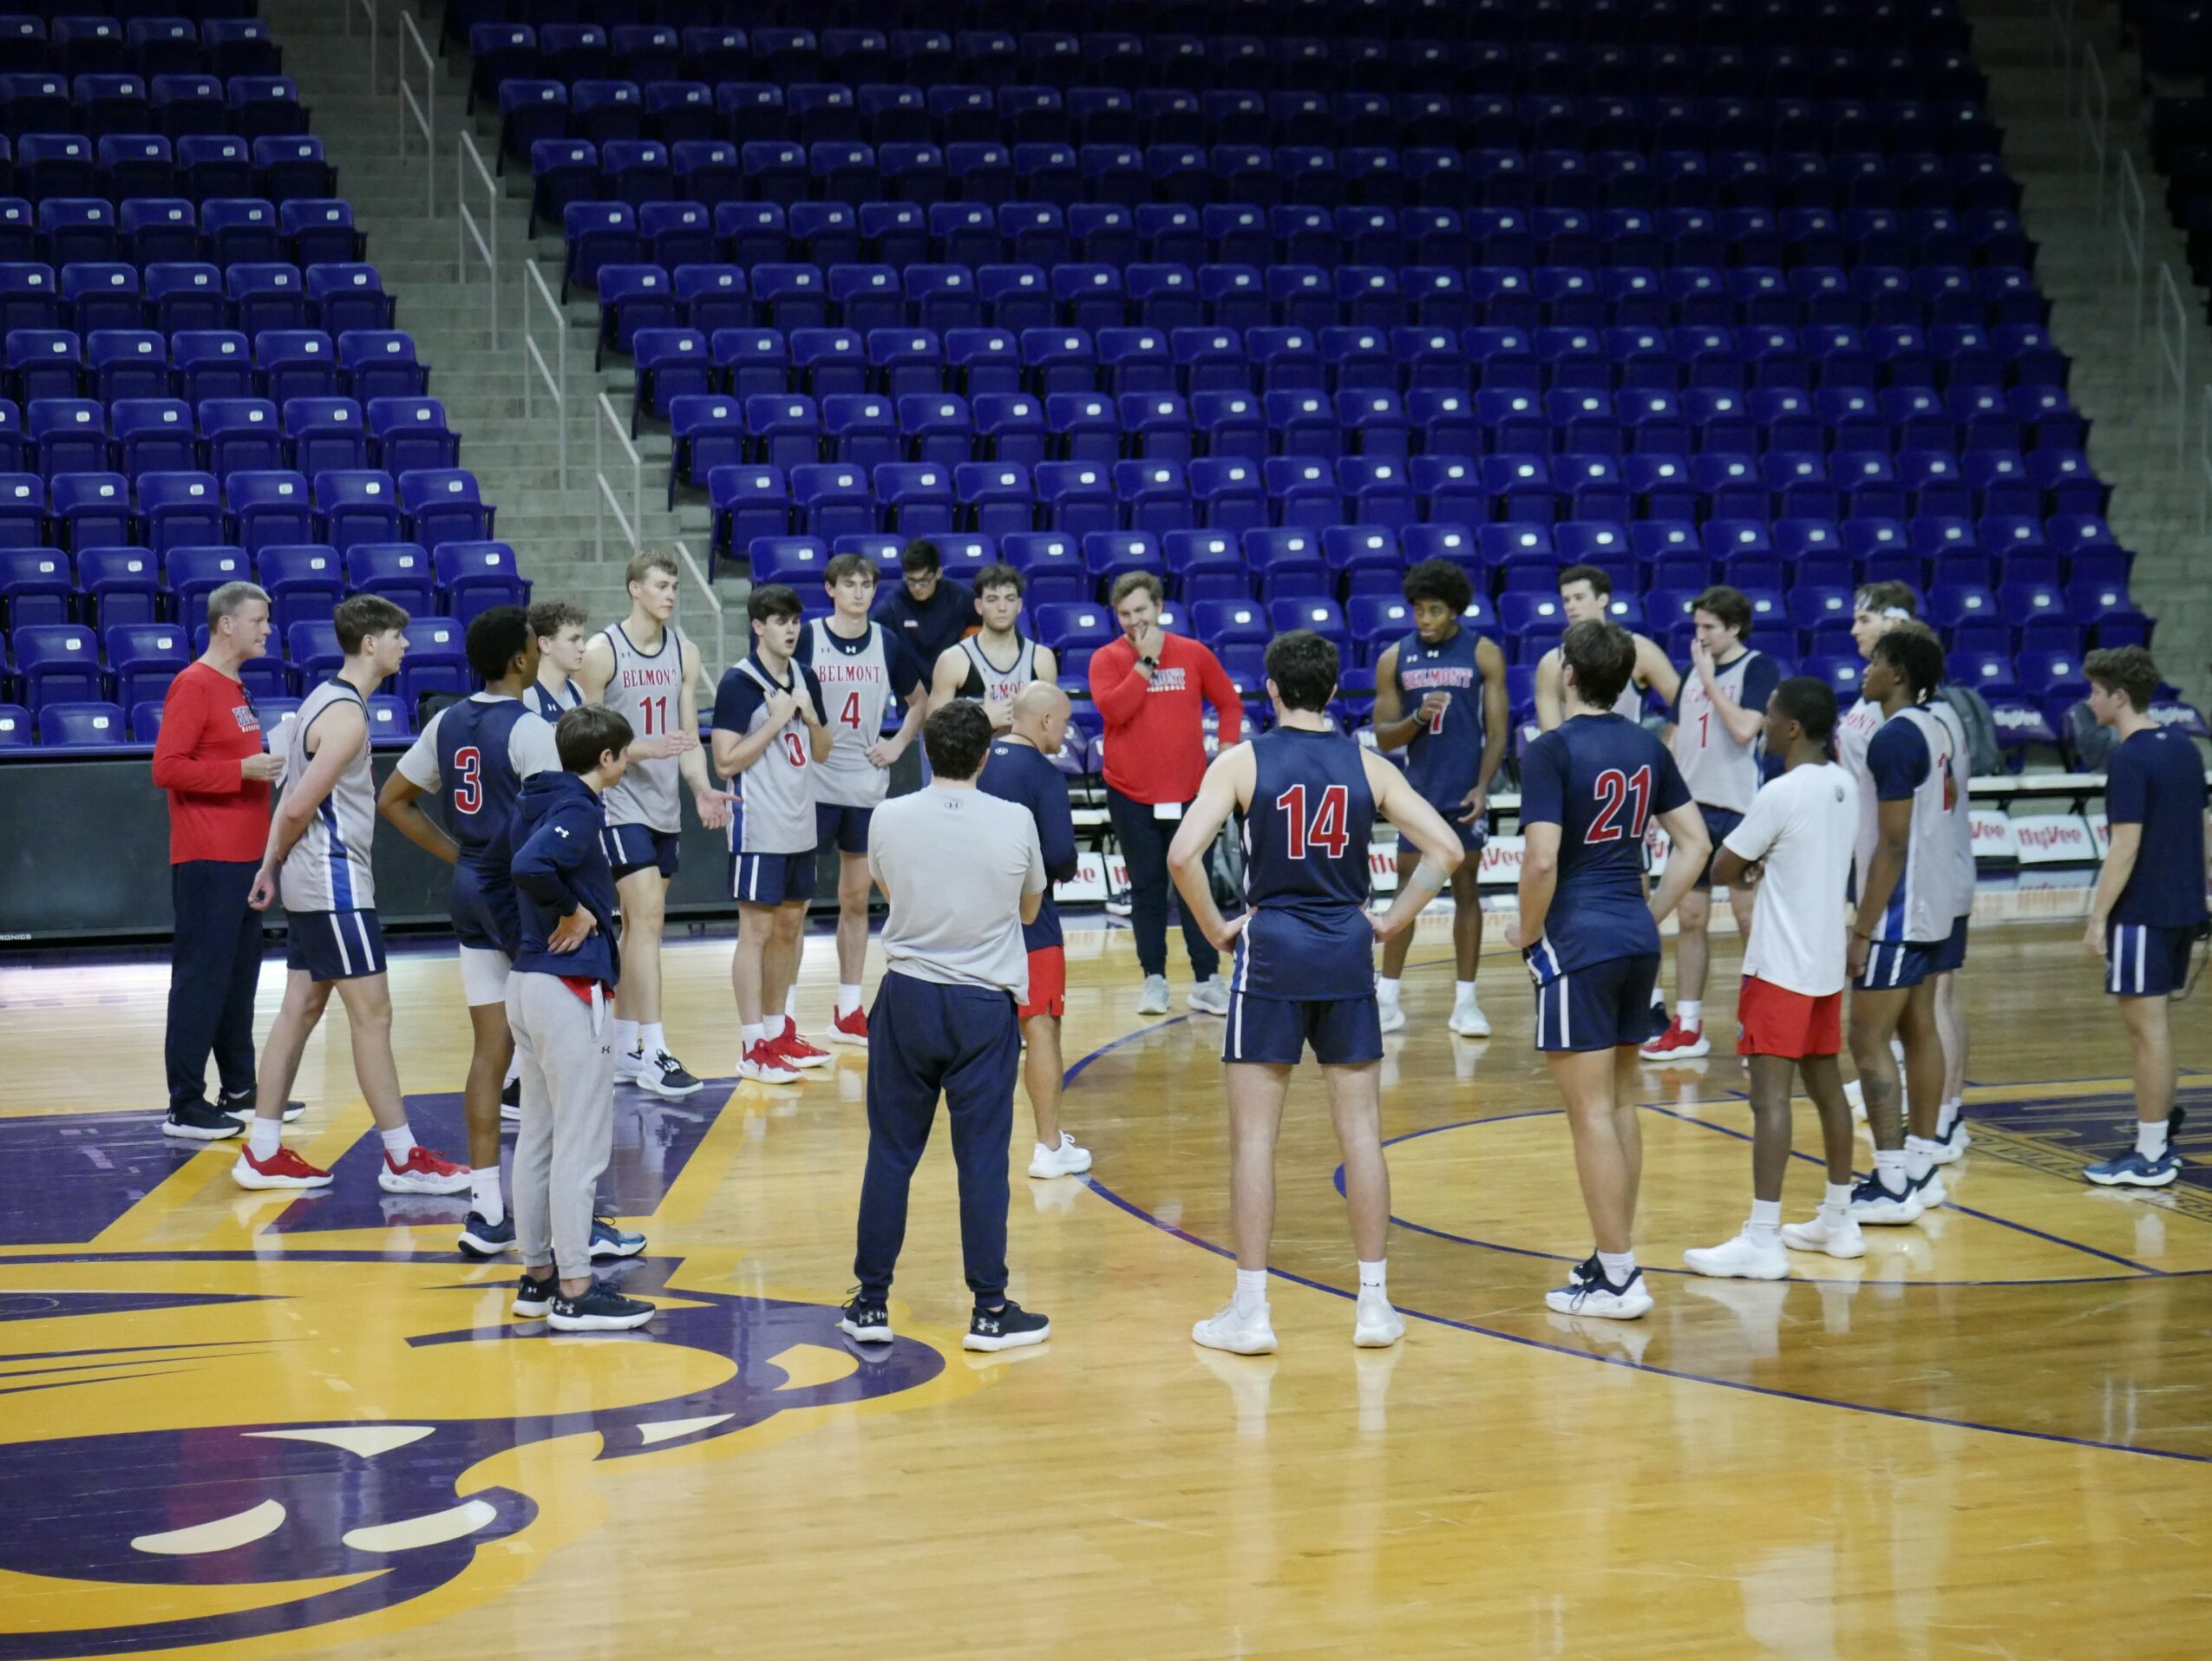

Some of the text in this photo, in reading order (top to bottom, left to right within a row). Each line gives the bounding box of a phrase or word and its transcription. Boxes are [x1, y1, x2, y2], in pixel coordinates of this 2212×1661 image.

[819, 664, 880, 683] BELMONT
[1401, 667, 1473, 690] BELMONT
[638, 695, 668, 736] 11
[839, 690, 862, 730] 4
[1698, 711, 1710, 749] 1
[783, 731, 809, 768] 0
[455, 746, 483, 814] 3
[1277, 784, 1350, 860] 14
[1584, 764, 1652, 844] 21
